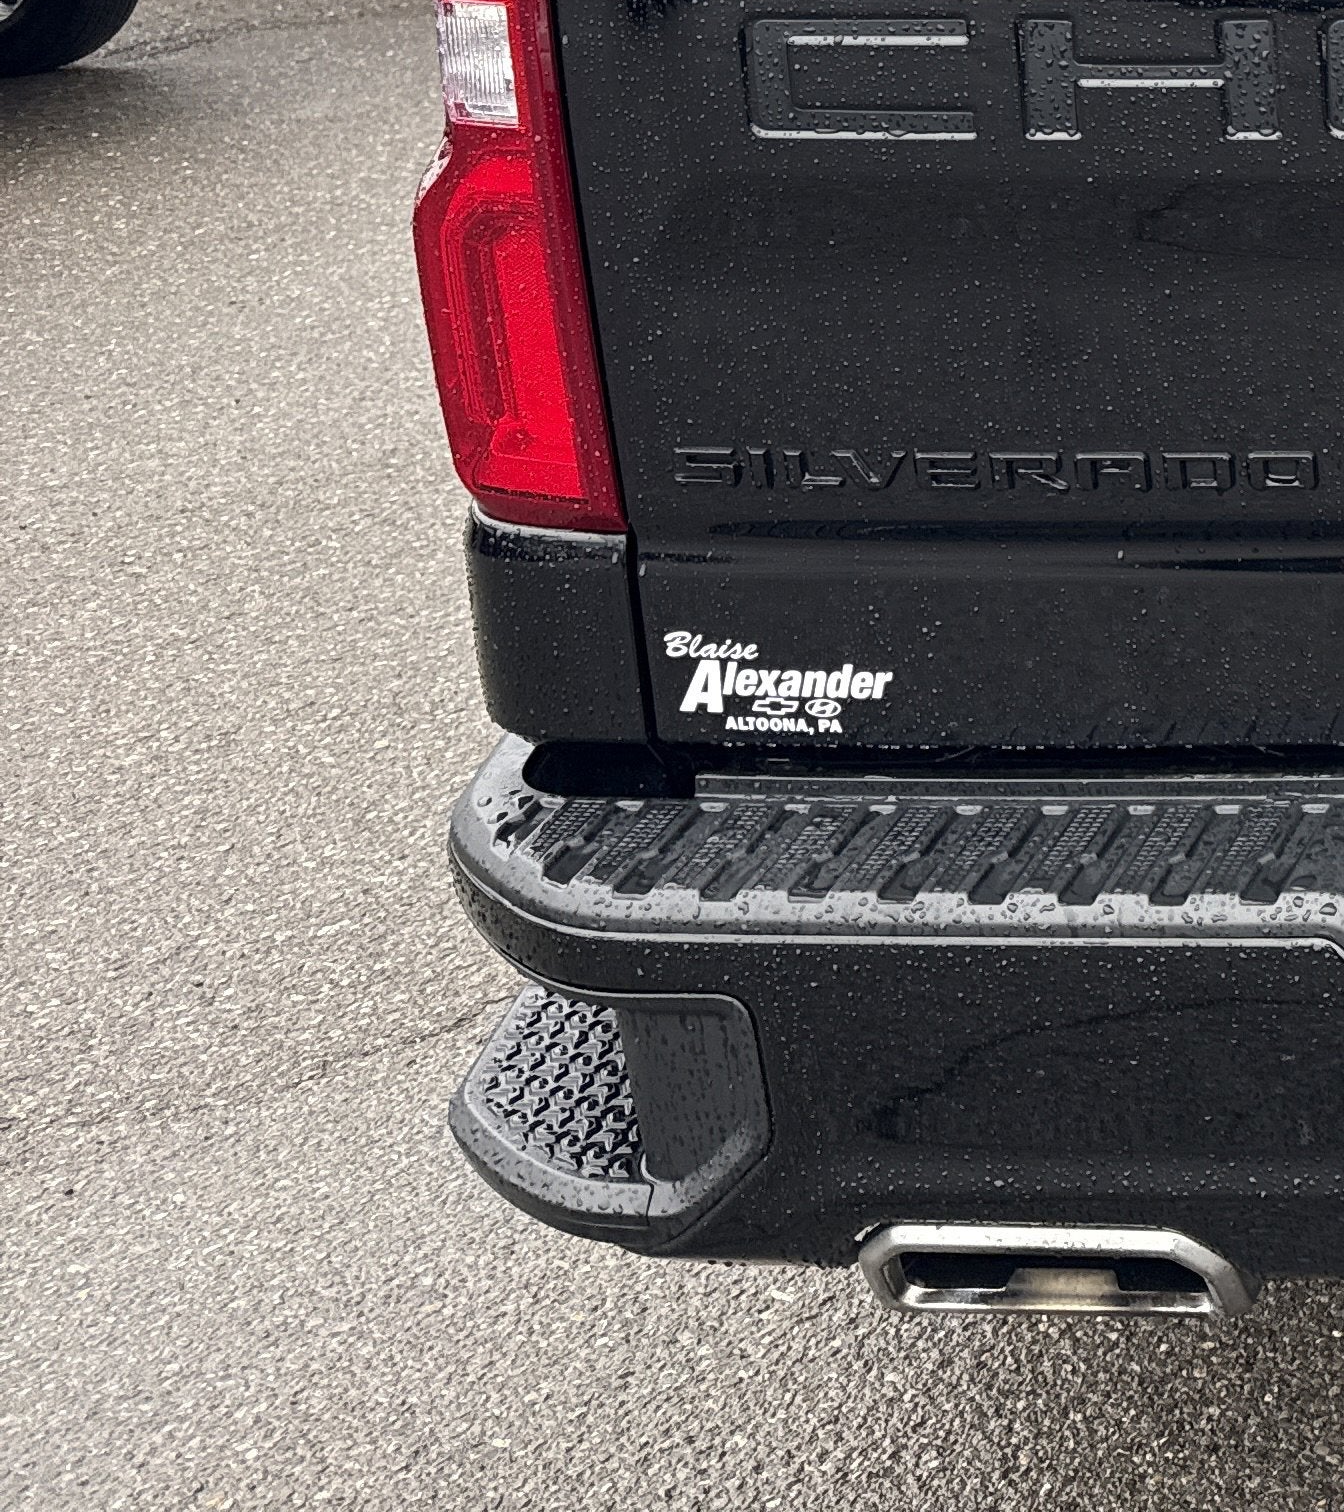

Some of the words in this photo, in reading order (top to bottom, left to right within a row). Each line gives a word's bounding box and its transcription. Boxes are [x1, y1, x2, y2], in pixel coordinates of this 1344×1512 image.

[673, 446, 1318, 491] SILVERADO
[663, 630, 759, 660] Blaise
[679, 659, 893, 713] Alexander
[725, 715, 814, 735] ALTOONA,
[817, 718, 843, 734] PA
